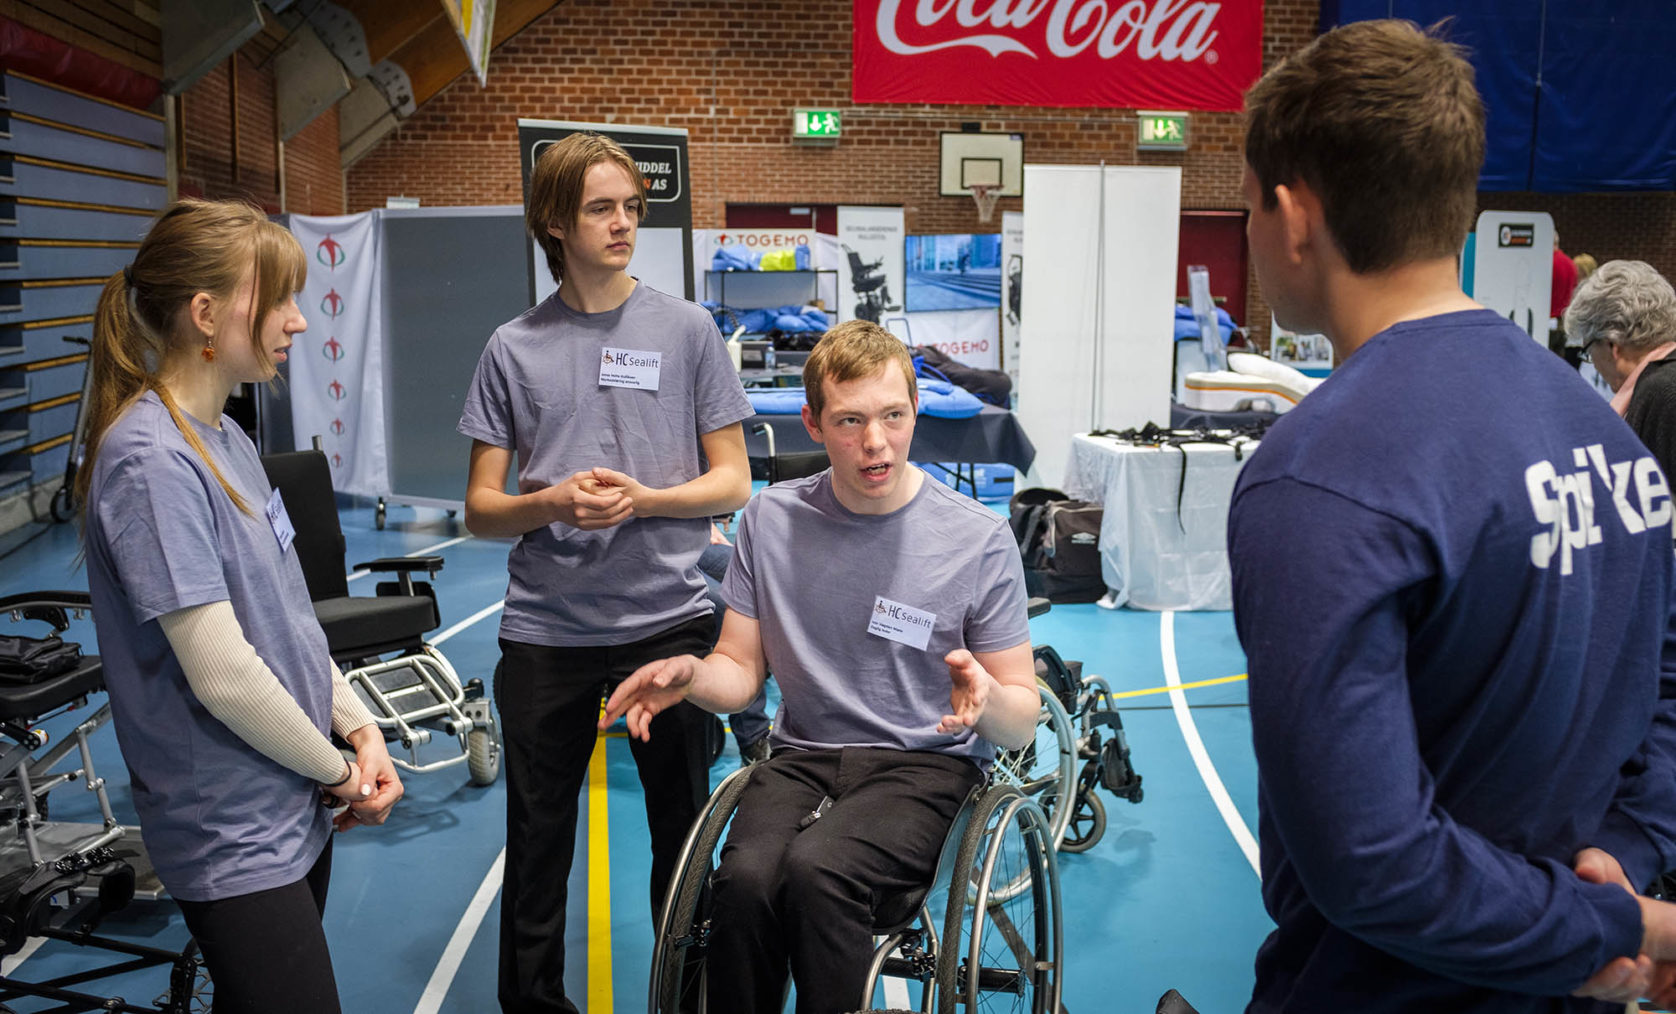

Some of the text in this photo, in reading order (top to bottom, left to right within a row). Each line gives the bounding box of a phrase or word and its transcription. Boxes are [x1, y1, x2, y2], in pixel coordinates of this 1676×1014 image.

[636, 161, 672, 174] IDDEL
[651, 178, 668, 190] AS
[737, 234, 809, 246] TOGEMO
[615, 352, 629, 366] HC
[1525, 443, 1673, 576] Spike
[888, 604, 902, 620] HC
